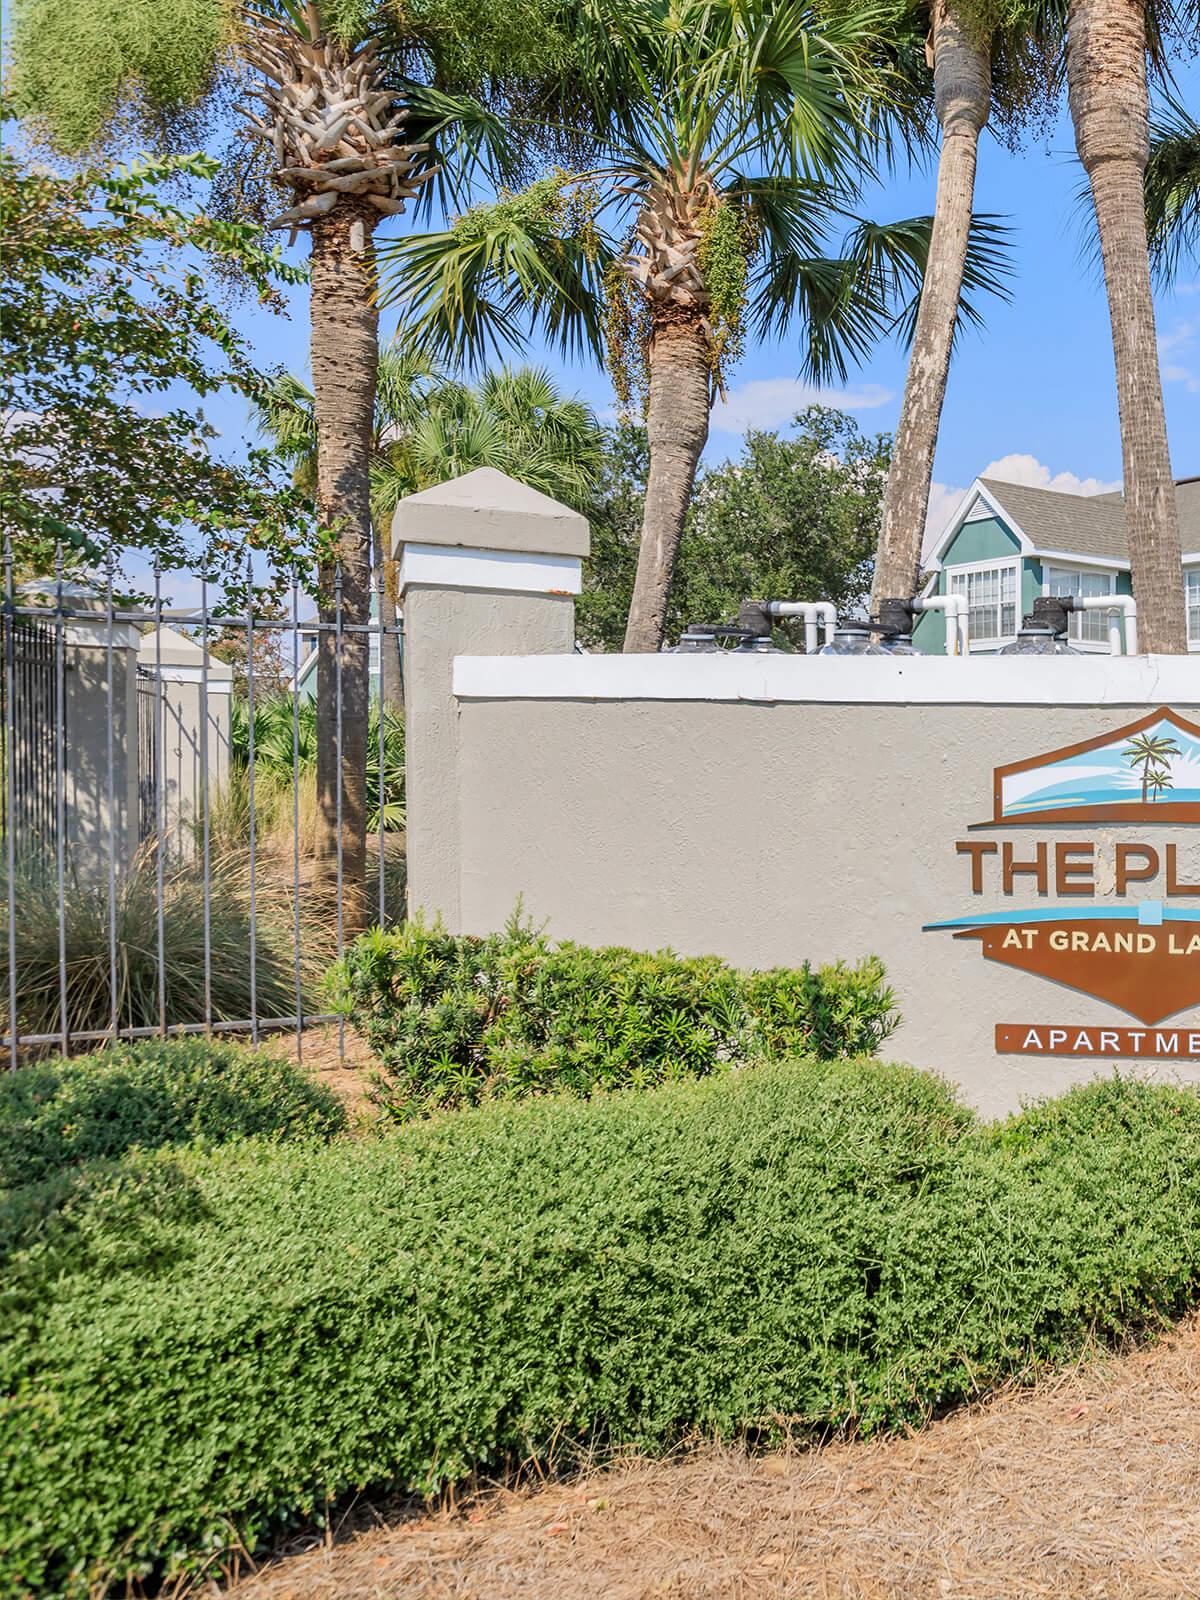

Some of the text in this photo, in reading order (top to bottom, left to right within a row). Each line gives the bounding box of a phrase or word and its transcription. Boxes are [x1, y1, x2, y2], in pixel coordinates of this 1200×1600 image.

[956, 841, 1094, 896] THE
[1002, 928, 1039, 950] AT
[1049, 930, 1157, 954] GRAND
